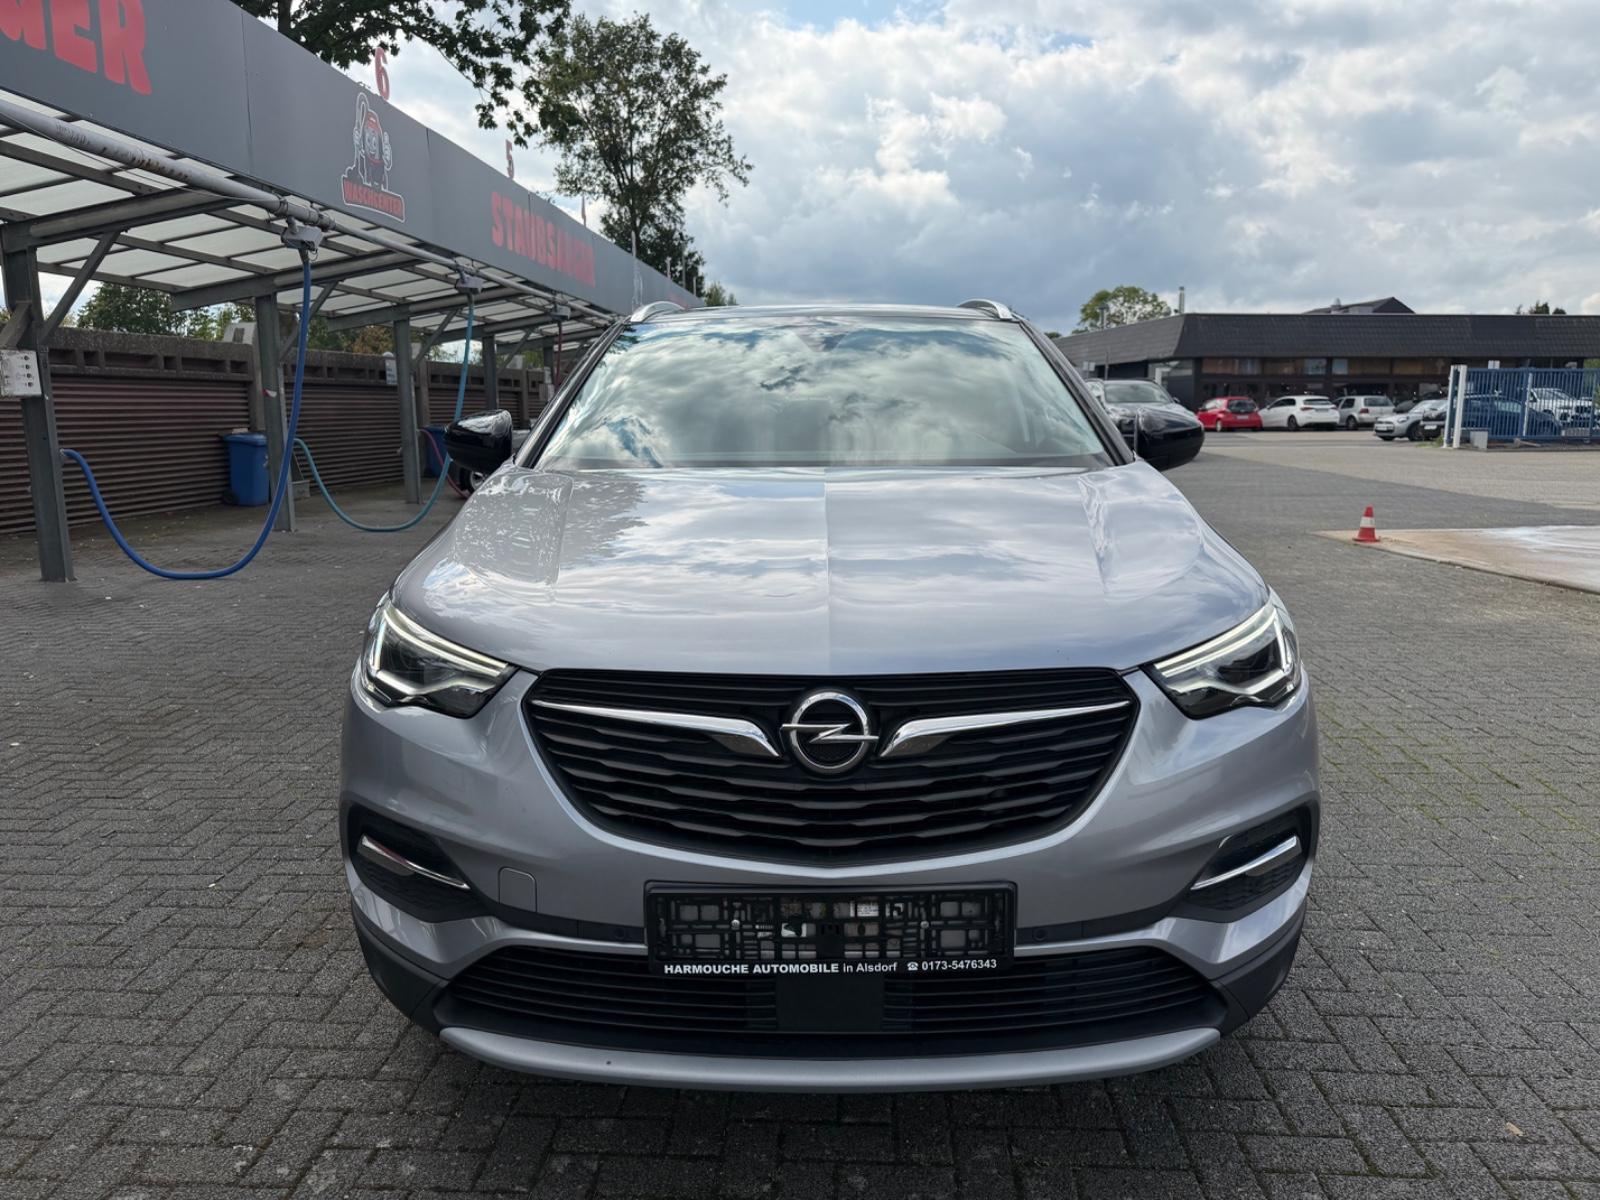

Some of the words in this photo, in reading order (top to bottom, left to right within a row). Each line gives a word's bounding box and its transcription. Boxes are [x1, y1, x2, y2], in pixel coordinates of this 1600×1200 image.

[375, 47, 390, 100] 6
[506, 139, 514, 178] 5
[663, 964, 749, 974] HARMOUCHE
[752, 963, 839, 974] AUTOMOBILE
[842, 962, 853, 973] in
[855, 961, 898, 973] Alsdorf
[921, 958, 998, 971] 0173-5476343
